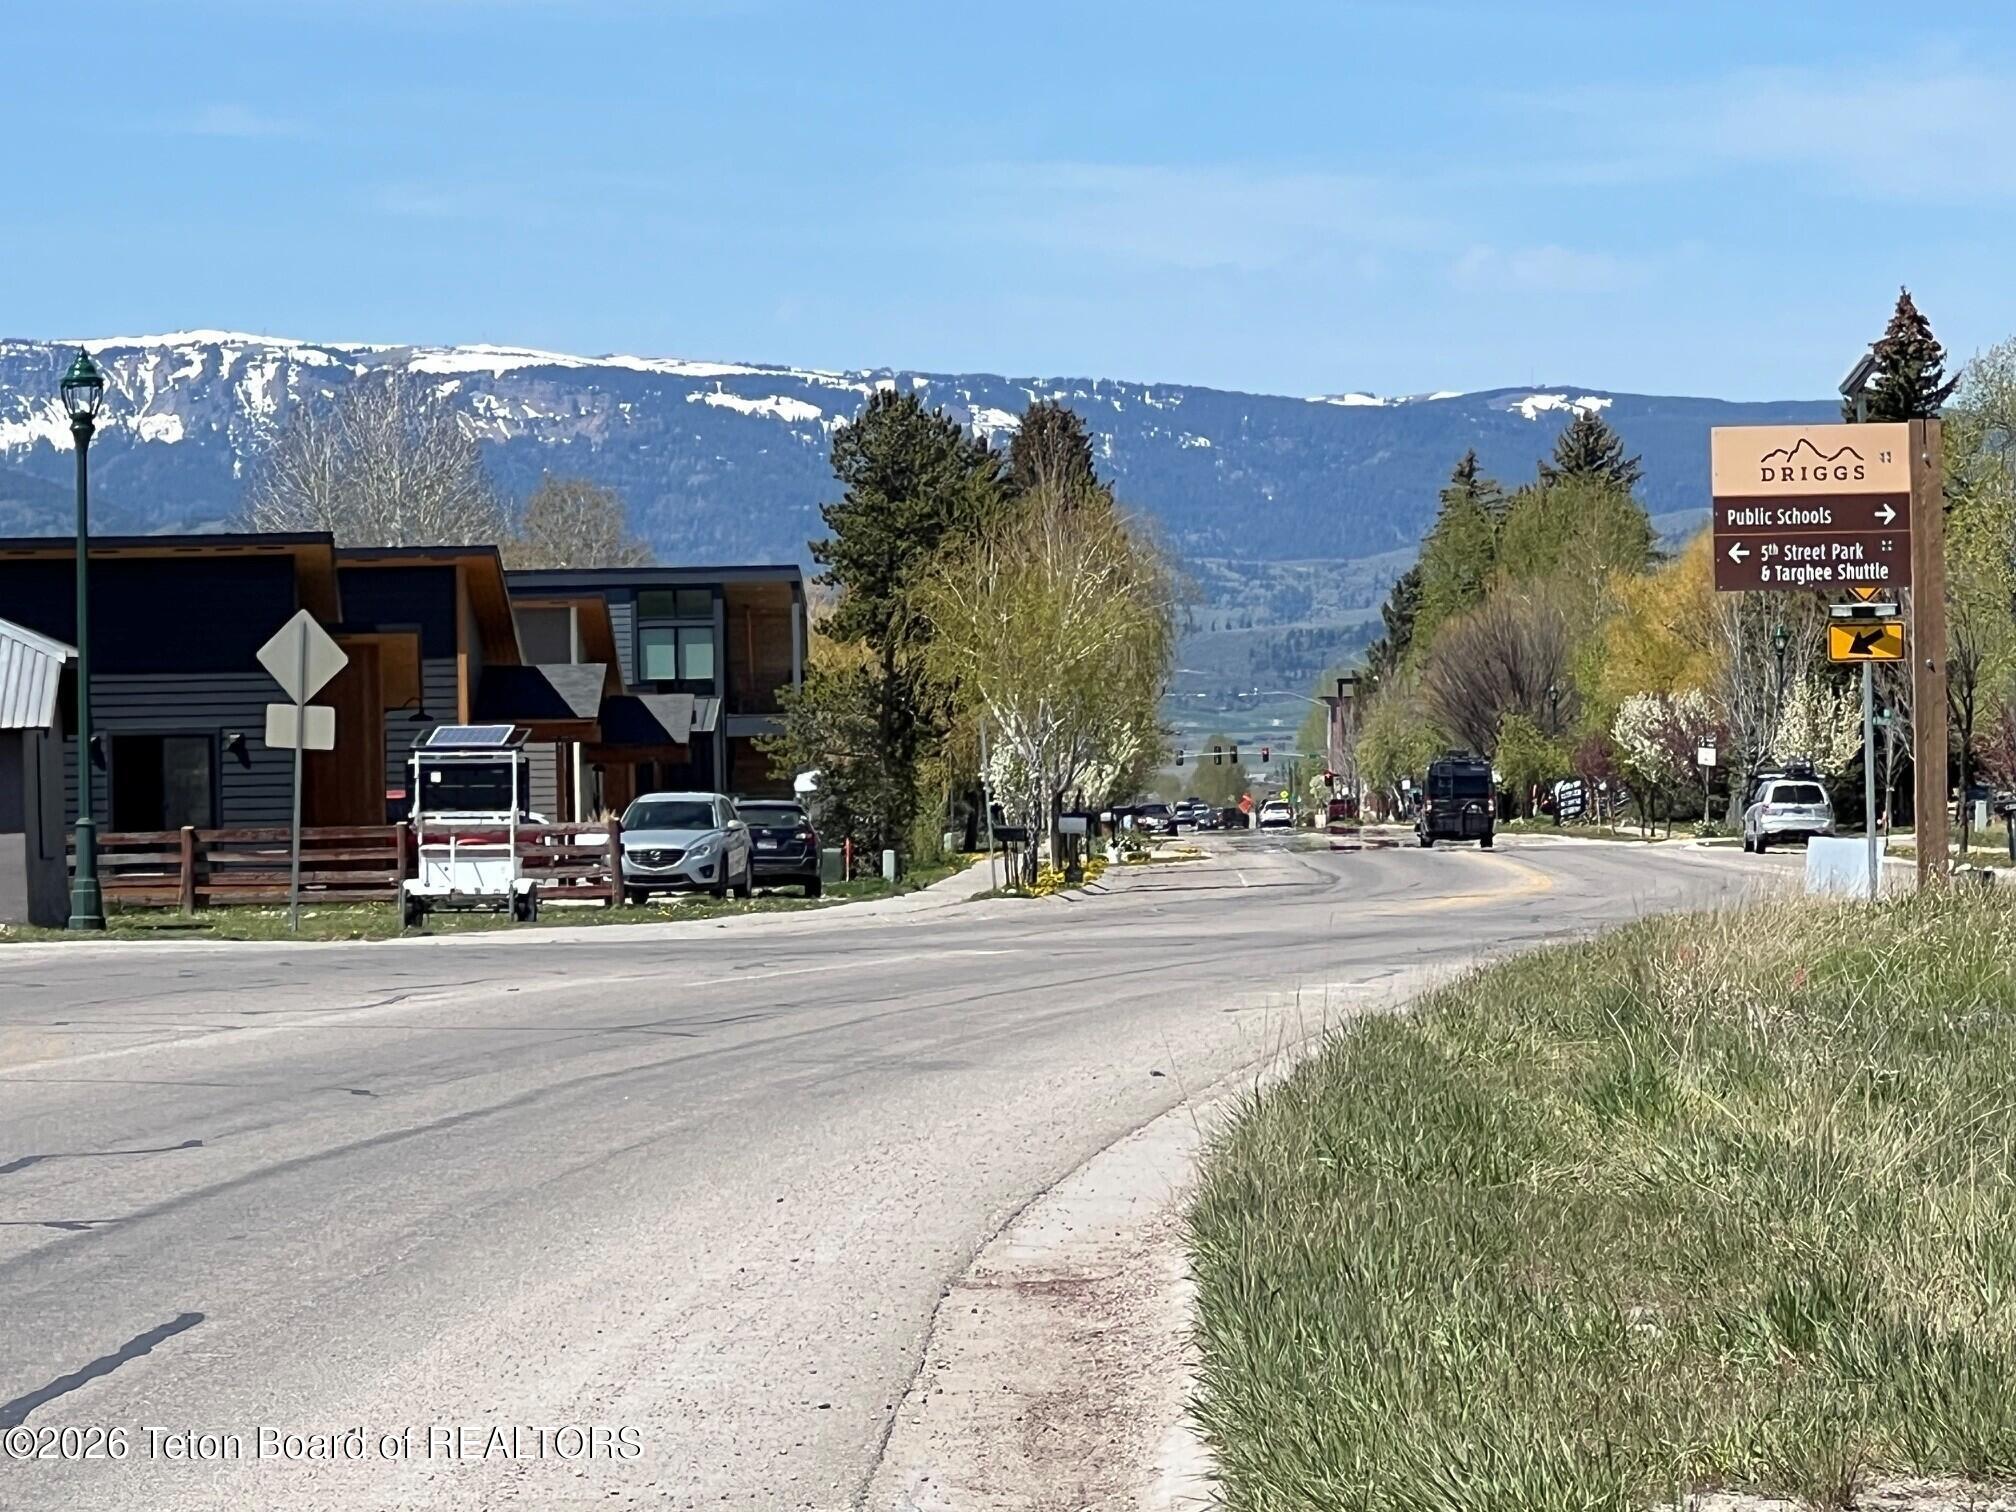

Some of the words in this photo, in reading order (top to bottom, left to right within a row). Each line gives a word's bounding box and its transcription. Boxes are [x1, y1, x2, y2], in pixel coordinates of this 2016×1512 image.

[1761, 465, 1865, 482] DRIGGS
[1727, 507, 1773, 526] Public
[1777, 506, 1832, 525] Schools
[1761, 543, 1779, 562] 5th
[1784, 543, 1826, 561] Street
[1832, 542, 1864, 560] Park
[1761, 565, 1771, 581] &
[1774, 563, 1832, 585] Targhee
[1838, 562, 1889, 581] Shuttle
